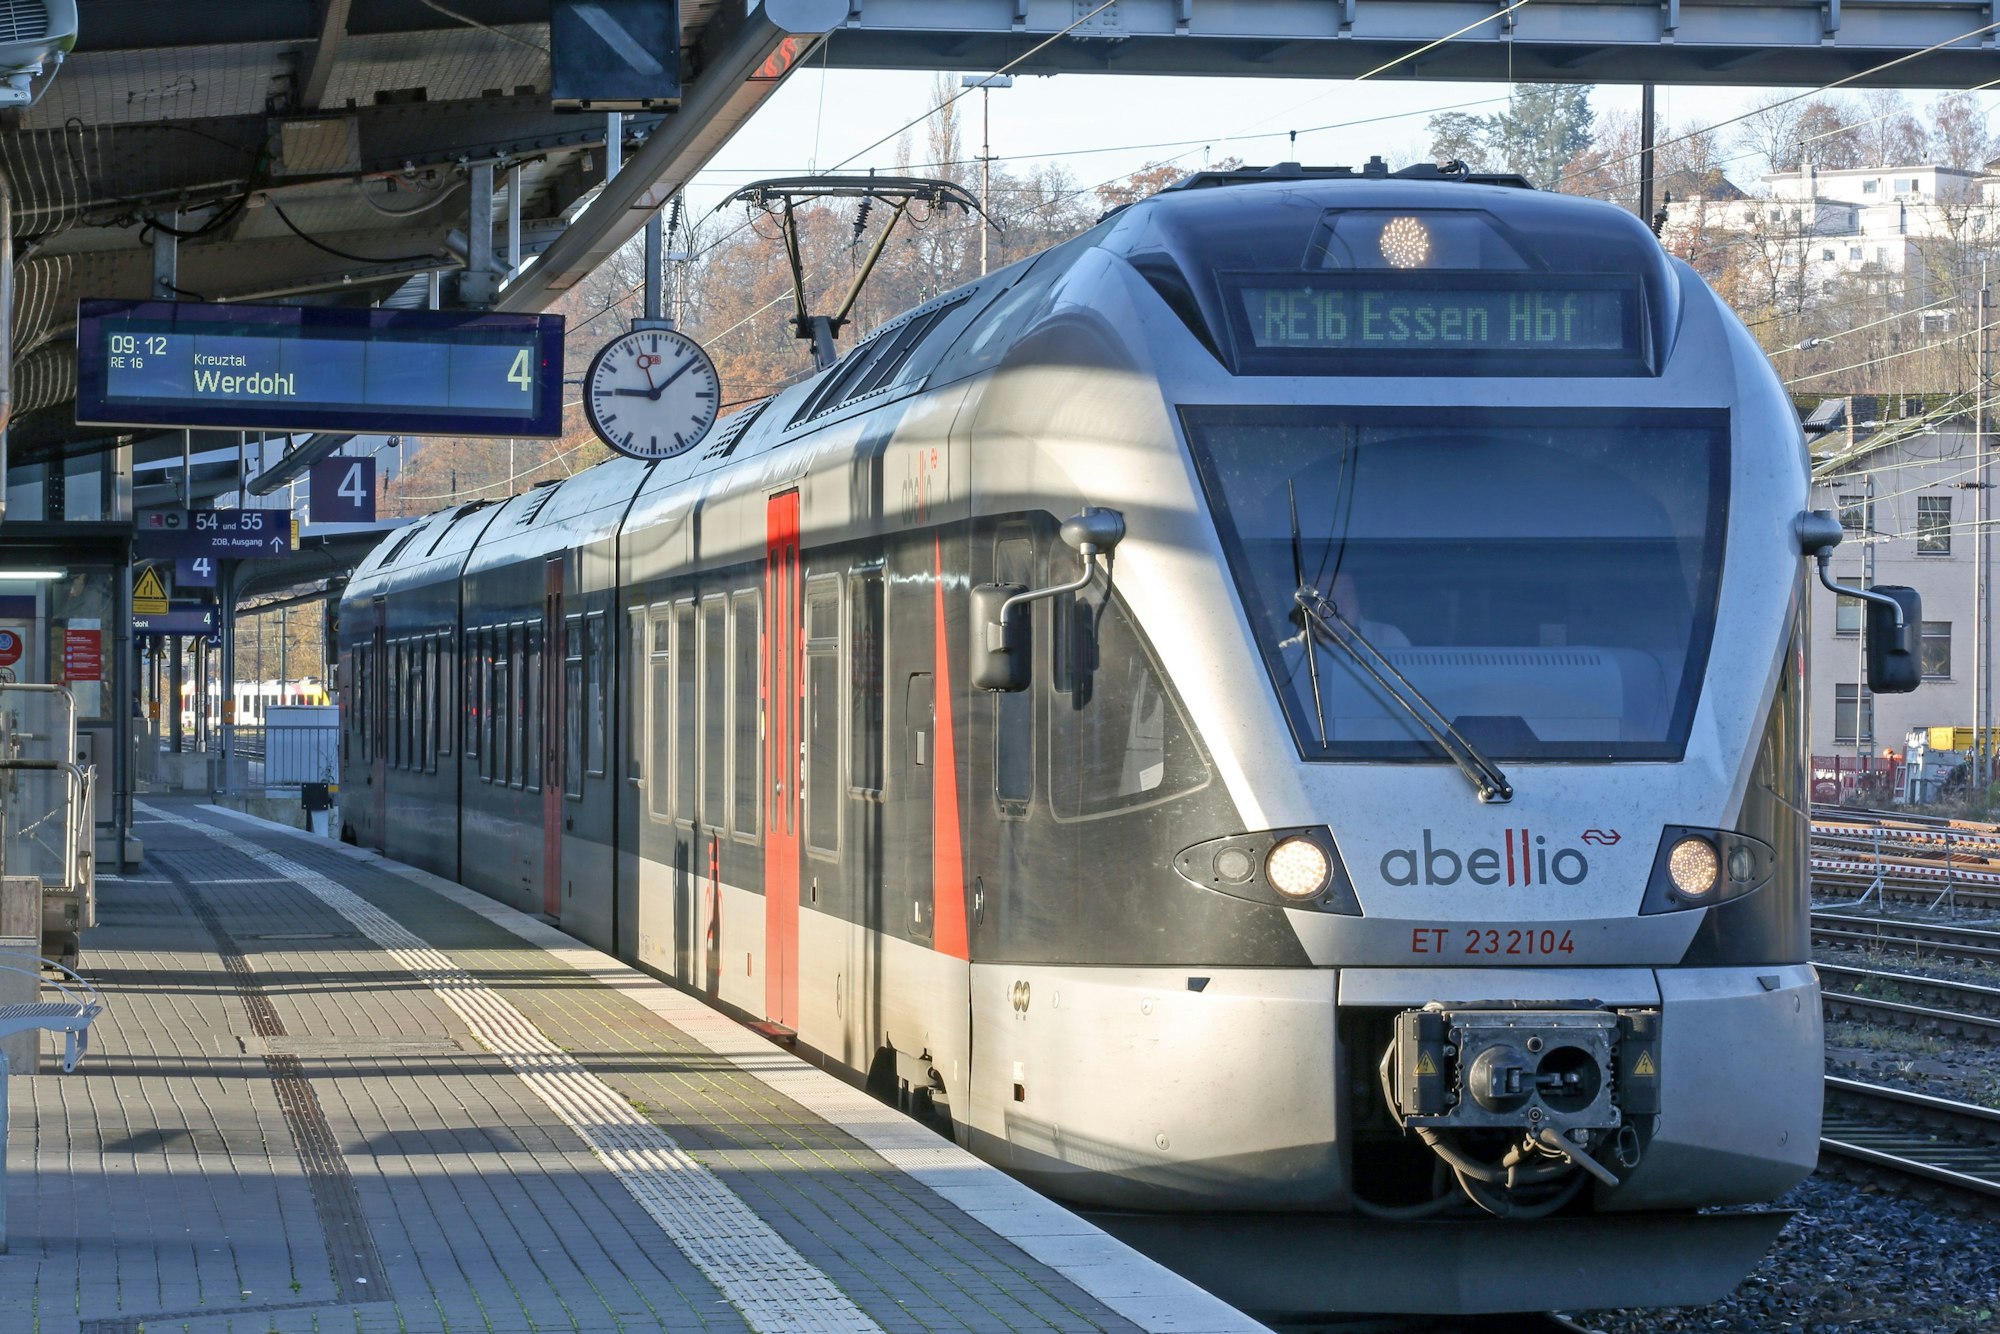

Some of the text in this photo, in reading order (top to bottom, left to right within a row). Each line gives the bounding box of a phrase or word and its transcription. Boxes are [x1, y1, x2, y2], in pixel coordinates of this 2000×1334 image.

[1265, 290, 1577, 342] RE16 Essen Hbf
[110, 357, 143, 369] RE 16
[194, 353, 247, 367] Kreuztal
[507, 349, 532, 392] 4
[194, 370, 296, 396] Werdohl
[337, 462, 367, 507] 4
[195, 512, 263, 530] 54 und 55
[211, 537, 263, 548] ZOB, Ausgang
[192, 557, 211, 577] 4
[203, 612, 211, 624] 4
[1379, 828, 1589, 888] abellio
[1412, 928, 1449, 953] ET
